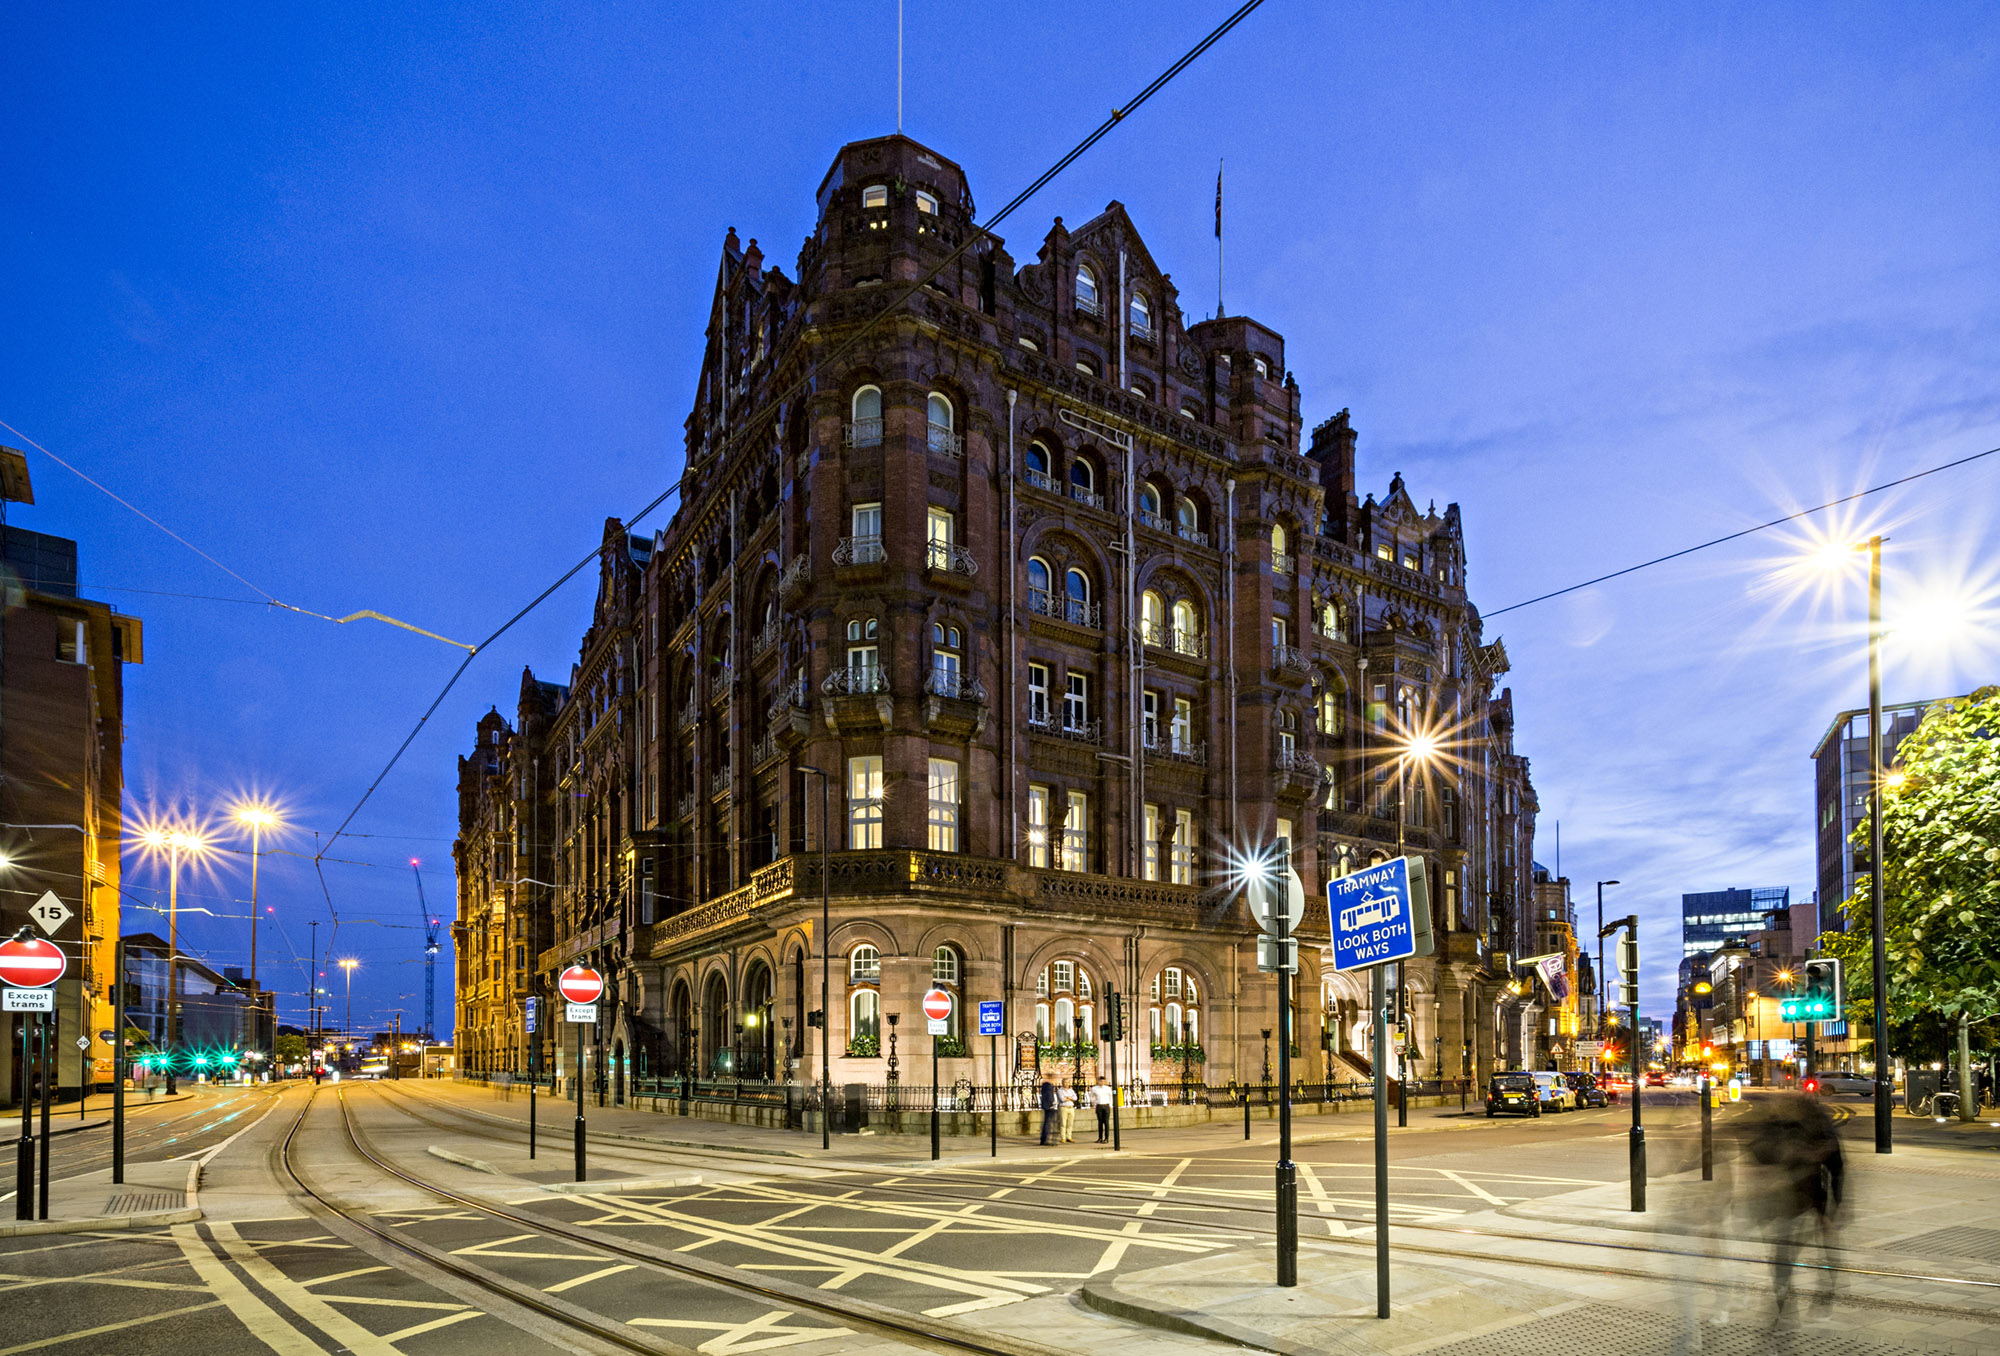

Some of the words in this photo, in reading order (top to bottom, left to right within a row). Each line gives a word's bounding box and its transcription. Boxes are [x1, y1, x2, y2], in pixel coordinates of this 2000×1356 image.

[1337, 866, 1396, 896] TRAMWAY
[38, 906, 62, 919] 15
[1338, 932, 1369, 951] LOOK
[1372, 922, 1407, 941] BOTH
[1355, 941, 1390, 960] WAYS
[8, 991, 49, 1001] Except
